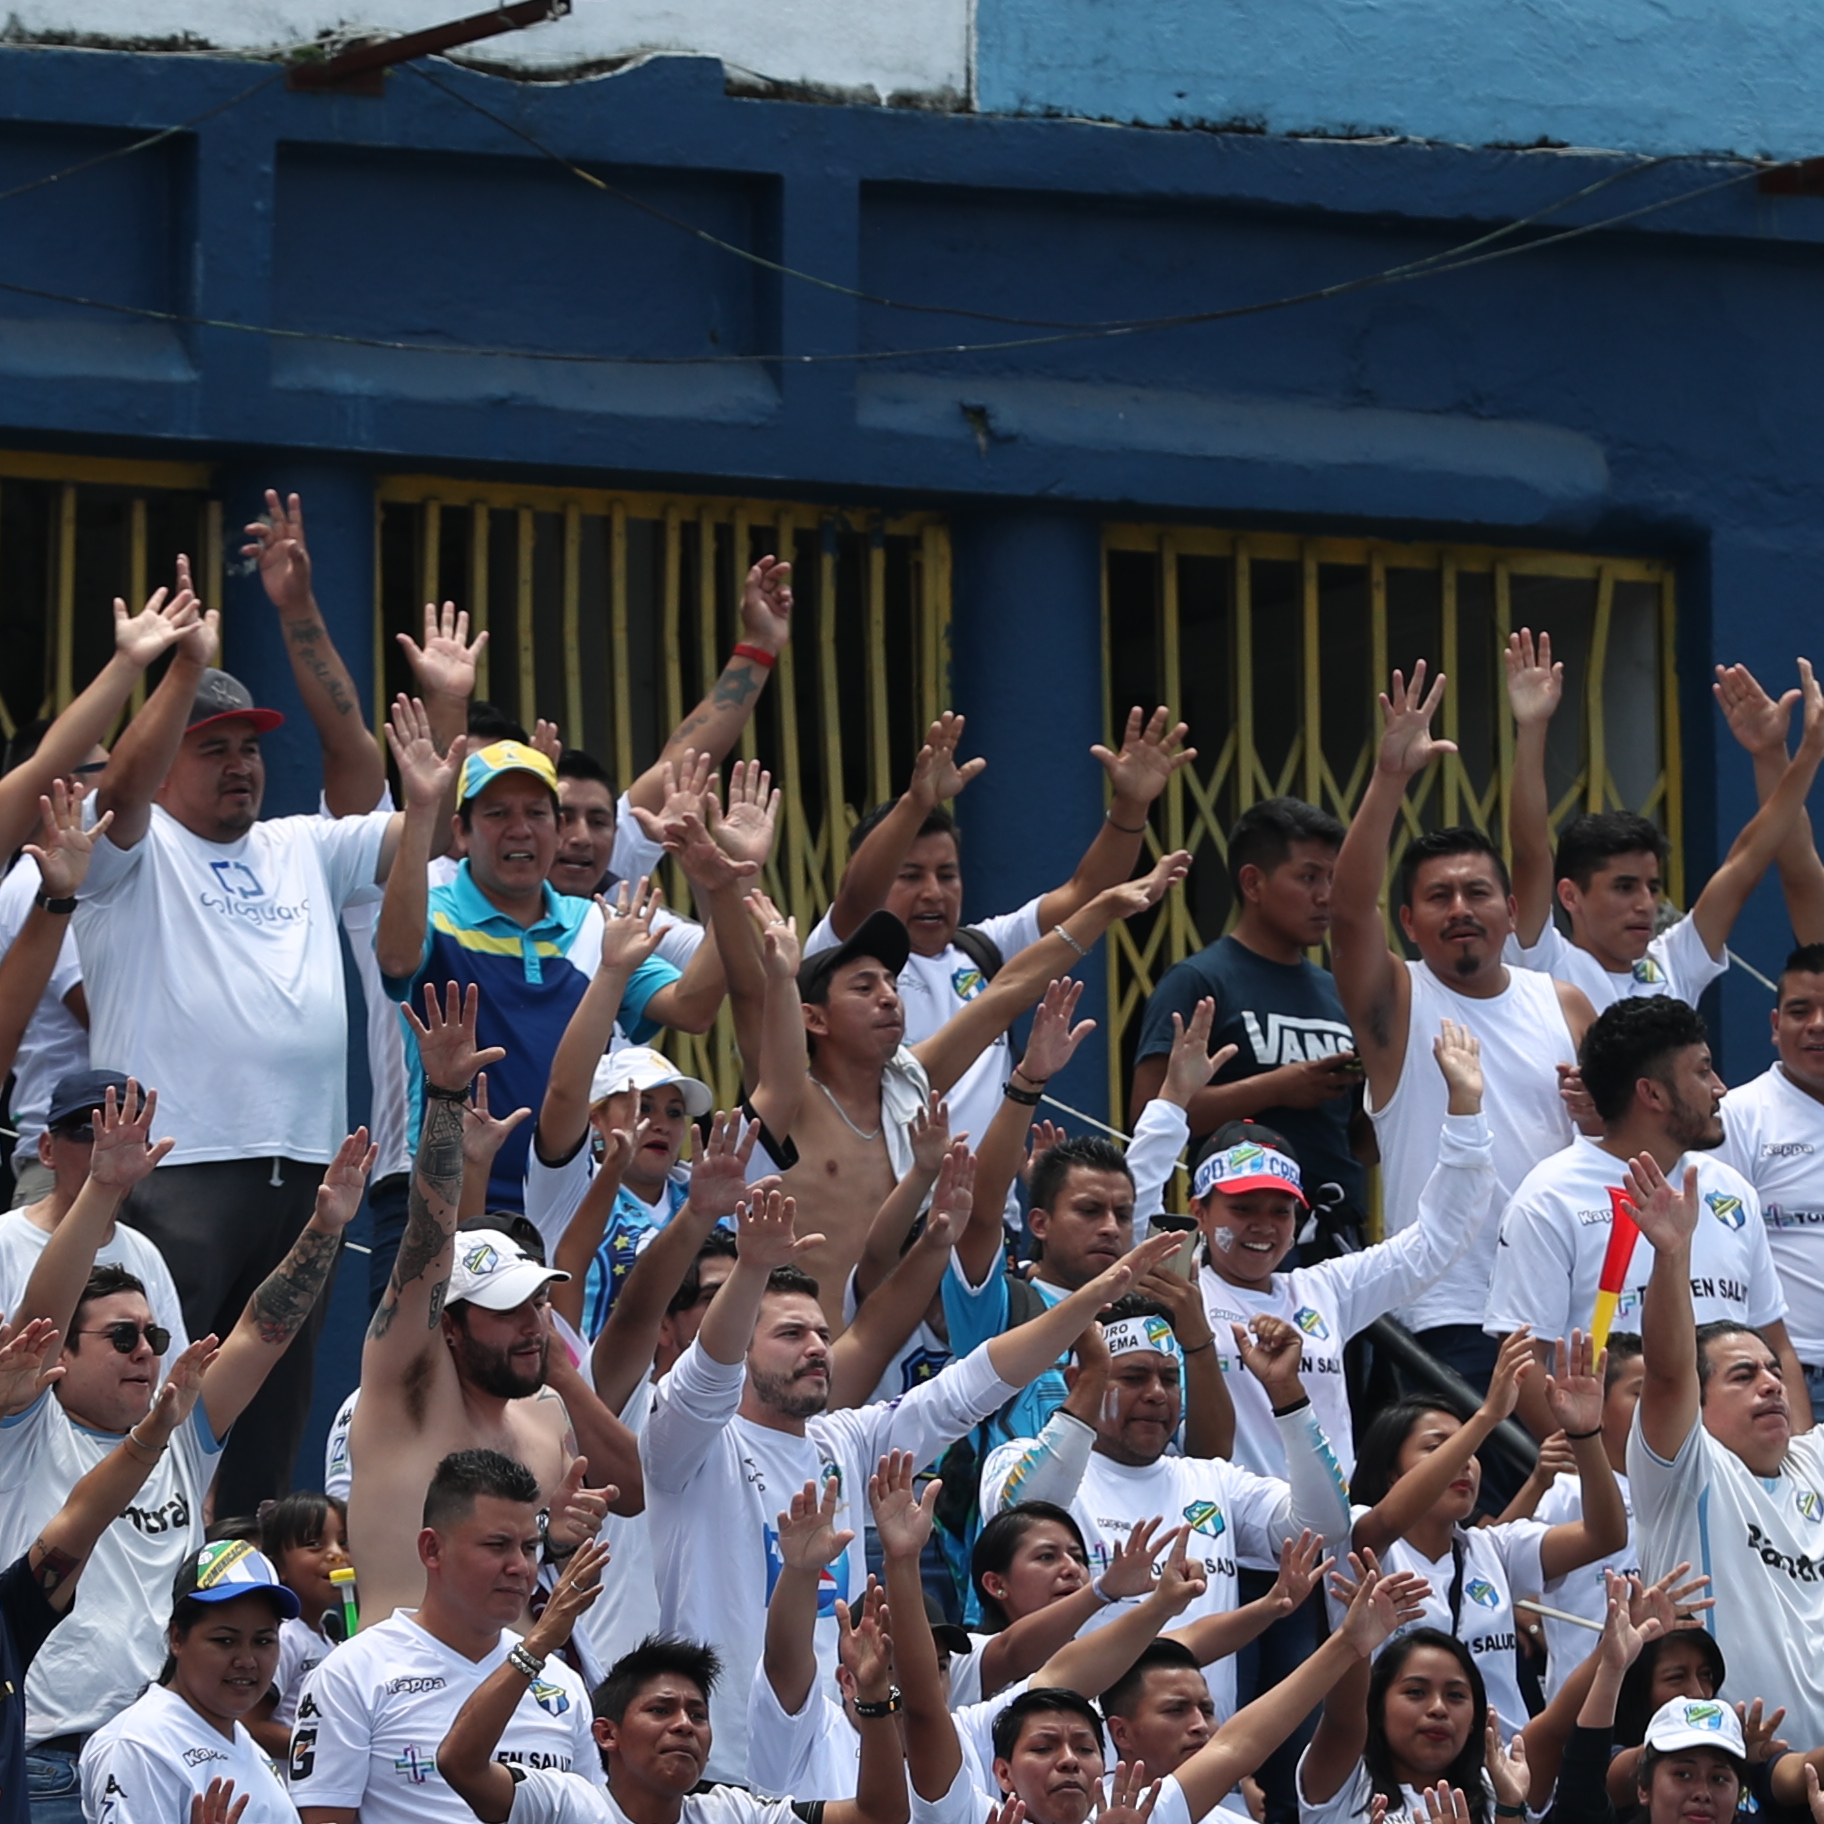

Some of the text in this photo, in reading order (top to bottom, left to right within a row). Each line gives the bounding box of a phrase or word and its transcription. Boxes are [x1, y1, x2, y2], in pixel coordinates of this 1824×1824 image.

[1761, 1141, 1814, 1158] Kappa
[1577, 1208, 1614, 1227] Kap
[1690, 1278, 1715, 1298] EN
[1102, 1323, 1129, 1342] URO
[1109, 1334, 1140, 1353] EMA
[385, 1677, 448, 1695] Kappa
